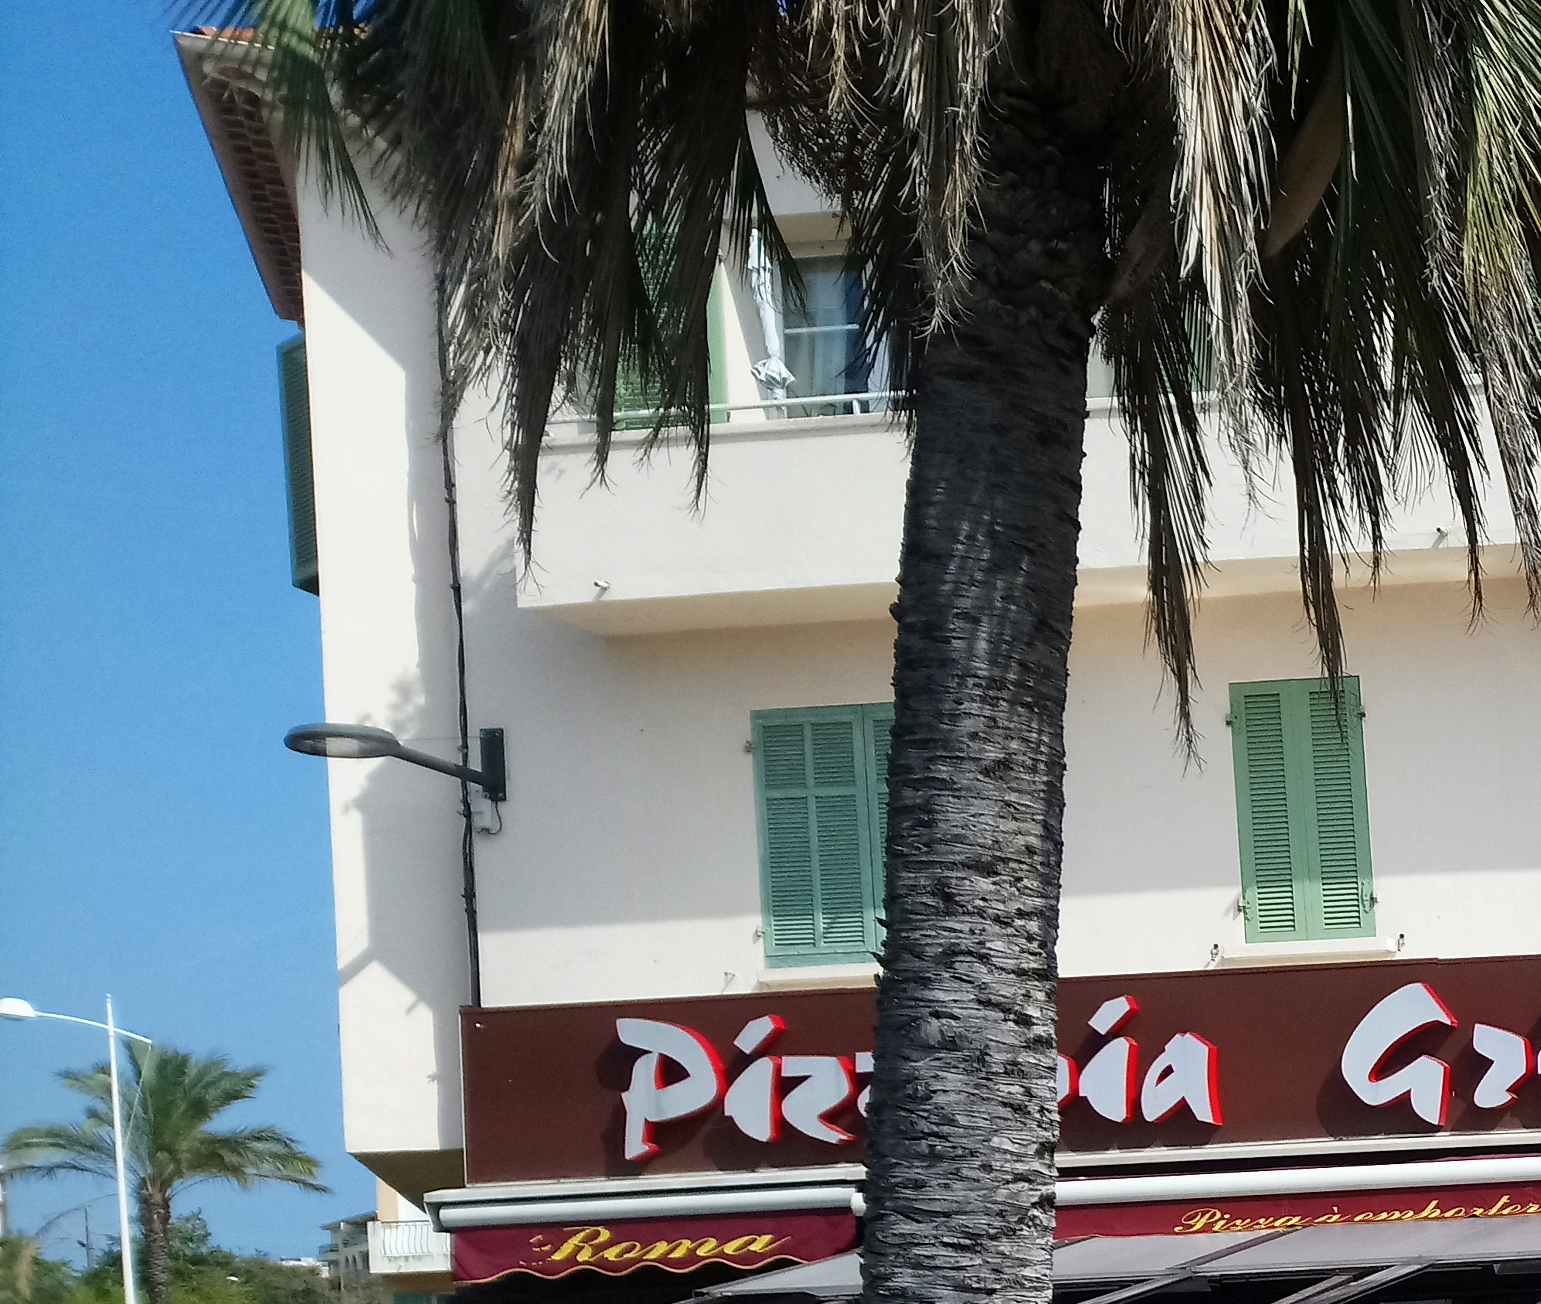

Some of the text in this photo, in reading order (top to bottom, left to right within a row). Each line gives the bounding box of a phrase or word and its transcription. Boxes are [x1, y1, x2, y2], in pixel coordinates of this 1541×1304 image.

[614, 994, 1223, 1160] Pizia
[1174, 1207, 1311, 1232] Pizza
[1313, 1206, 1350, 1224] à
[519, 1226, 791, 1265] Roma
